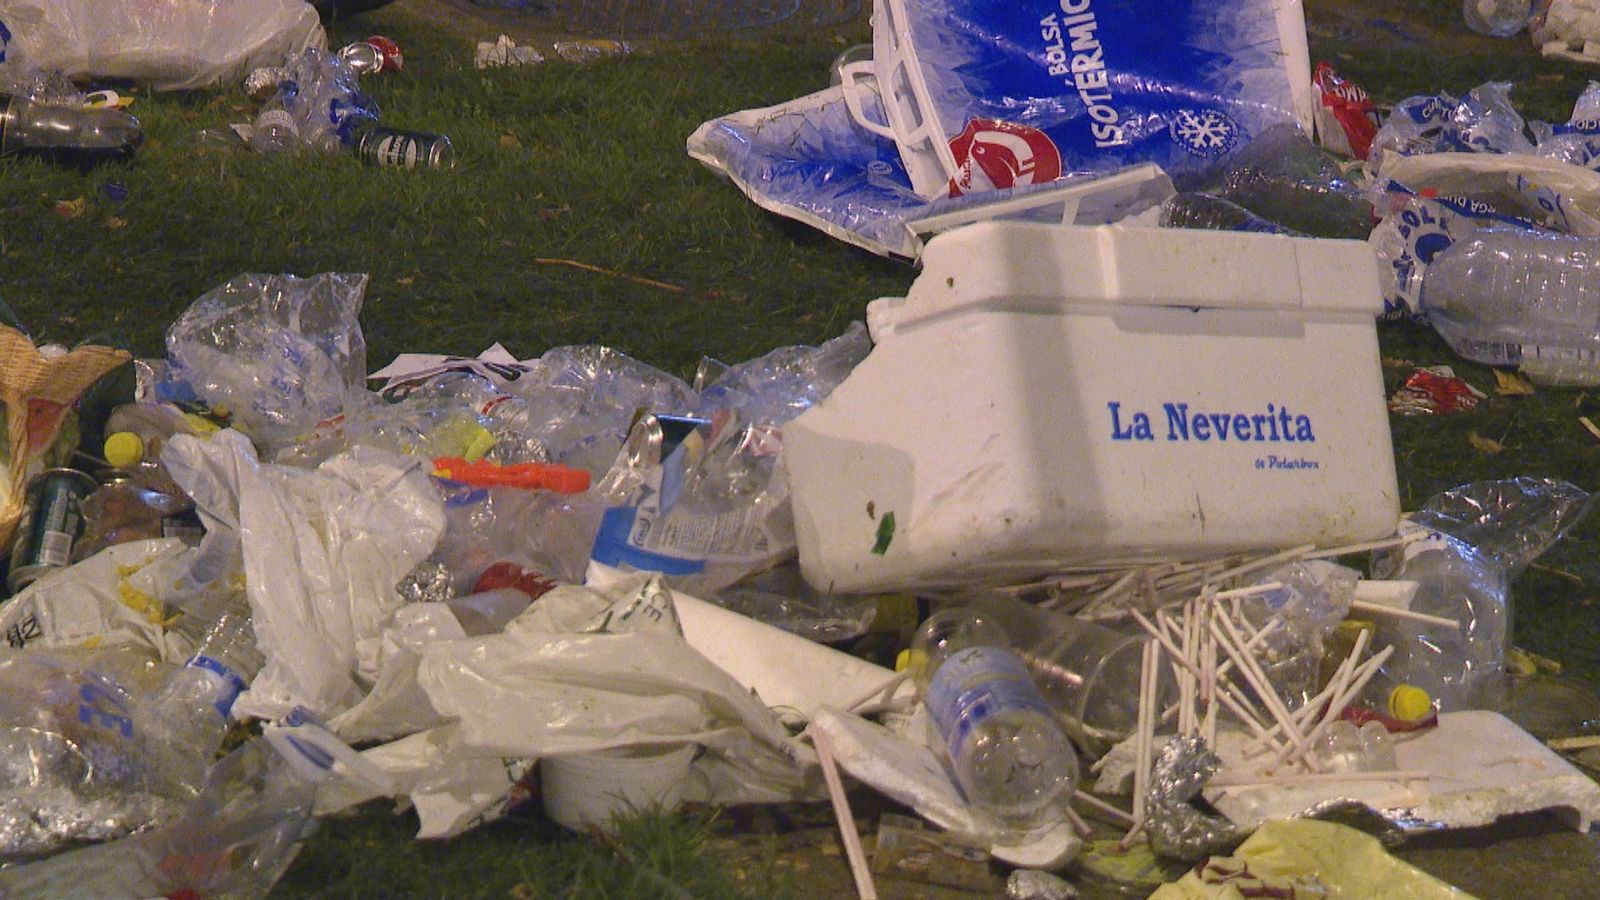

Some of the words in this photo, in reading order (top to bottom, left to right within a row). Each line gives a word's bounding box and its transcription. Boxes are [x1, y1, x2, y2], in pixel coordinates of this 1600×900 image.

[1039, 12, 1069, 77] BOLSA
[1107, 401, 1154, 441] La
[1162, 402, 1316, 442] Neverita
